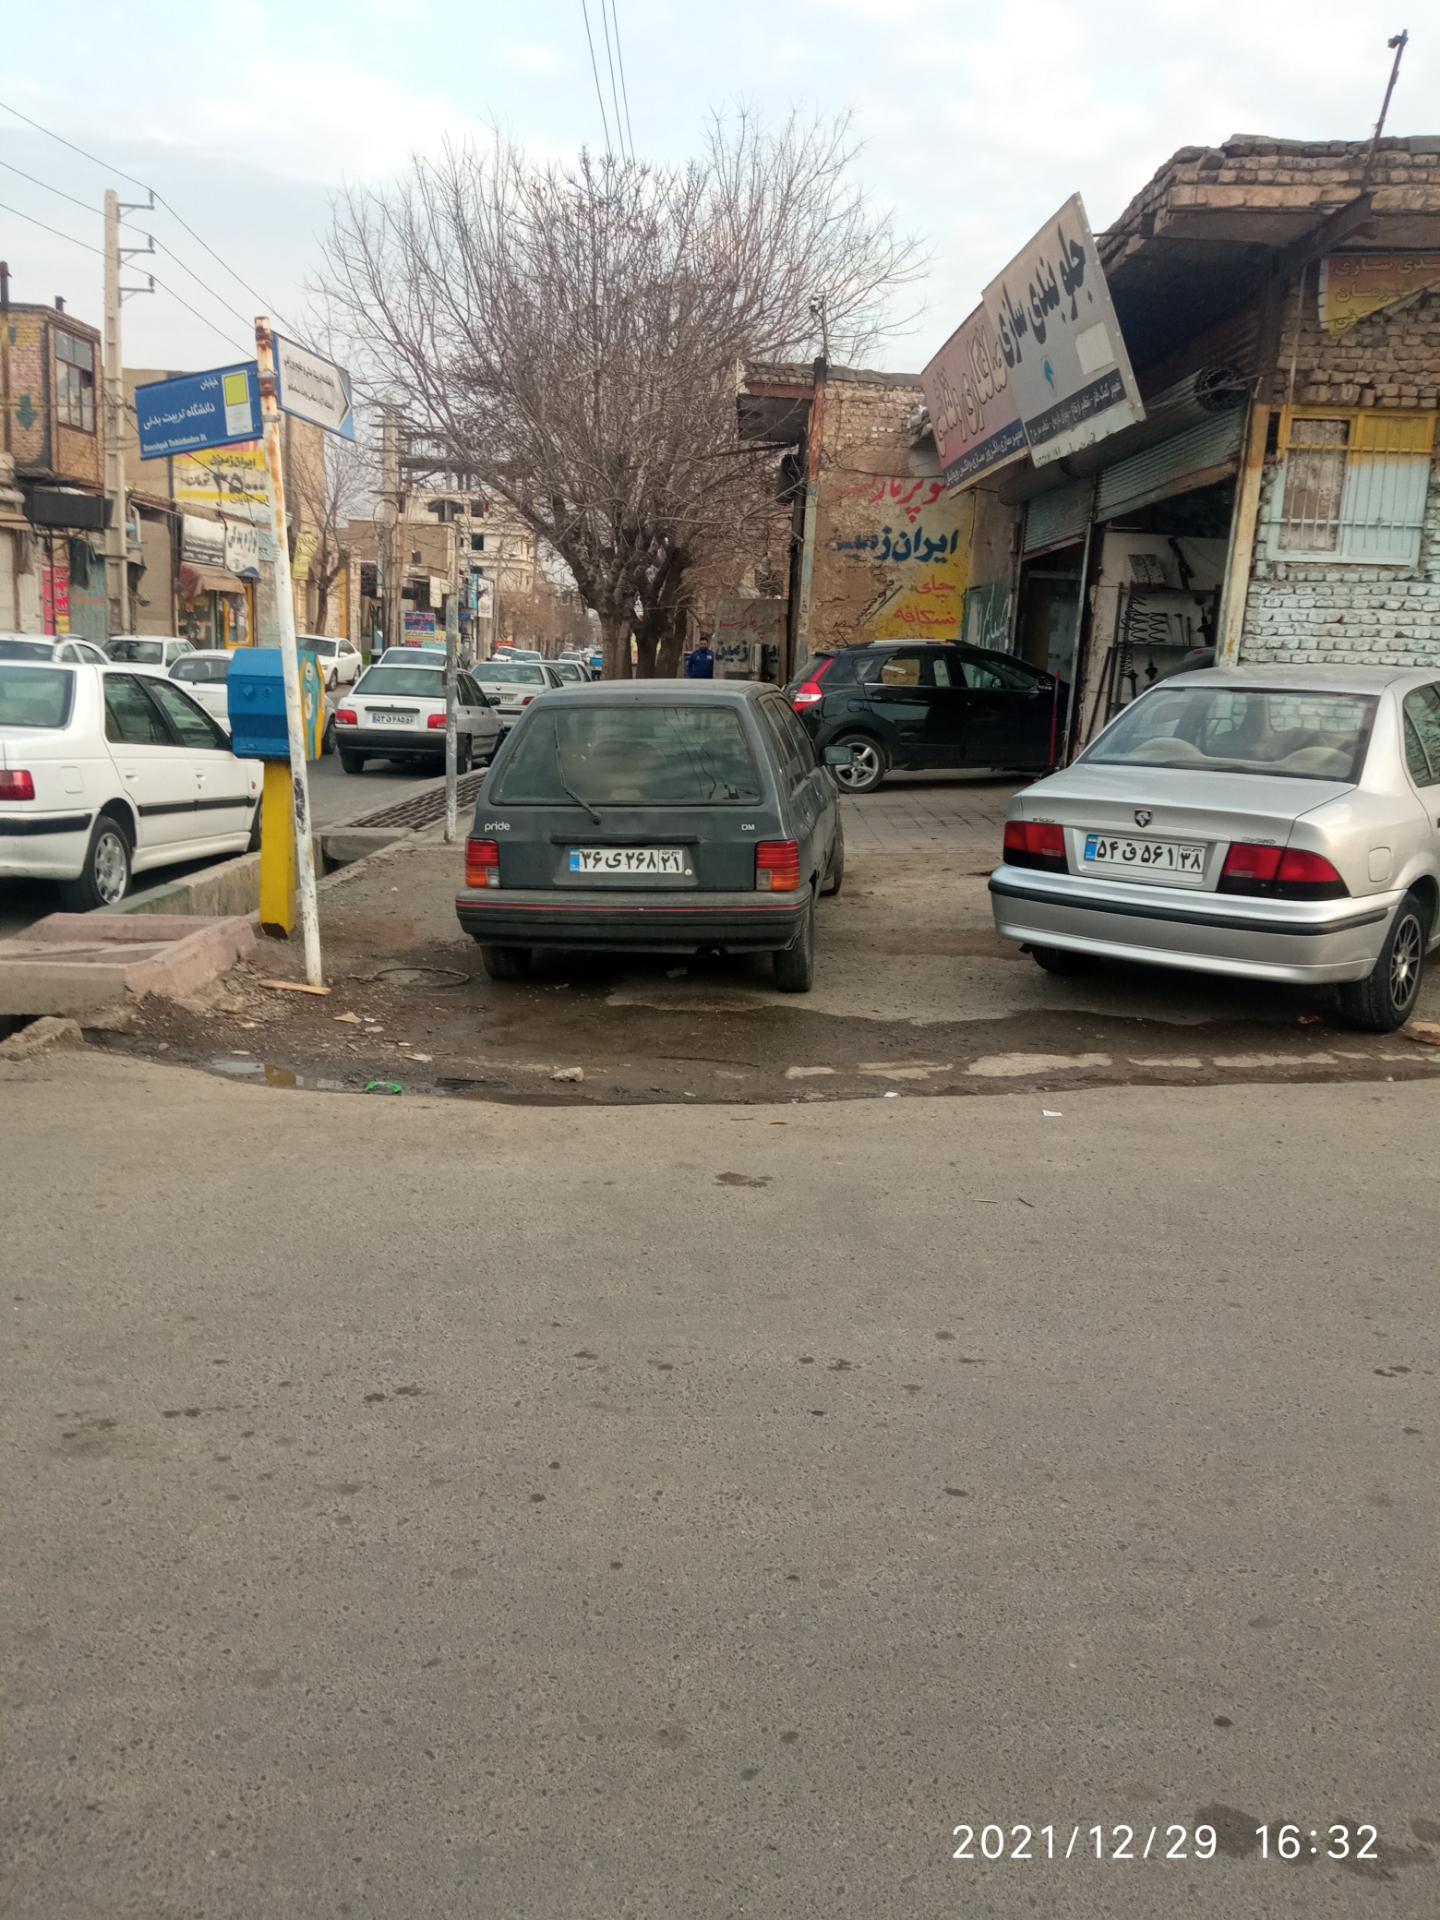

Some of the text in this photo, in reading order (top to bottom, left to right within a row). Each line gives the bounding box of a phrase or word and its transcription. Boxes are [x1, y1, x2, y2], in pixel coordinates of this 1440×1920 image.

[998, 282, 1027, 369] سازی
[143, 401, 216, 431] دانشگاه تربیت بدنی
[891, 526, 959, 563] ایران
[915, 574, 957, 604] چای
[893, 605, 957, 625] نسکافه
[484, 821, 511, 833] pride
[661, 856, 680, 872] ۲۱
[1097, 840, 1119, 860] ۵۴
[1141, 844, 1174, 867] ۵۶۱
[1181, 852, 1201, 870] ۳۸
